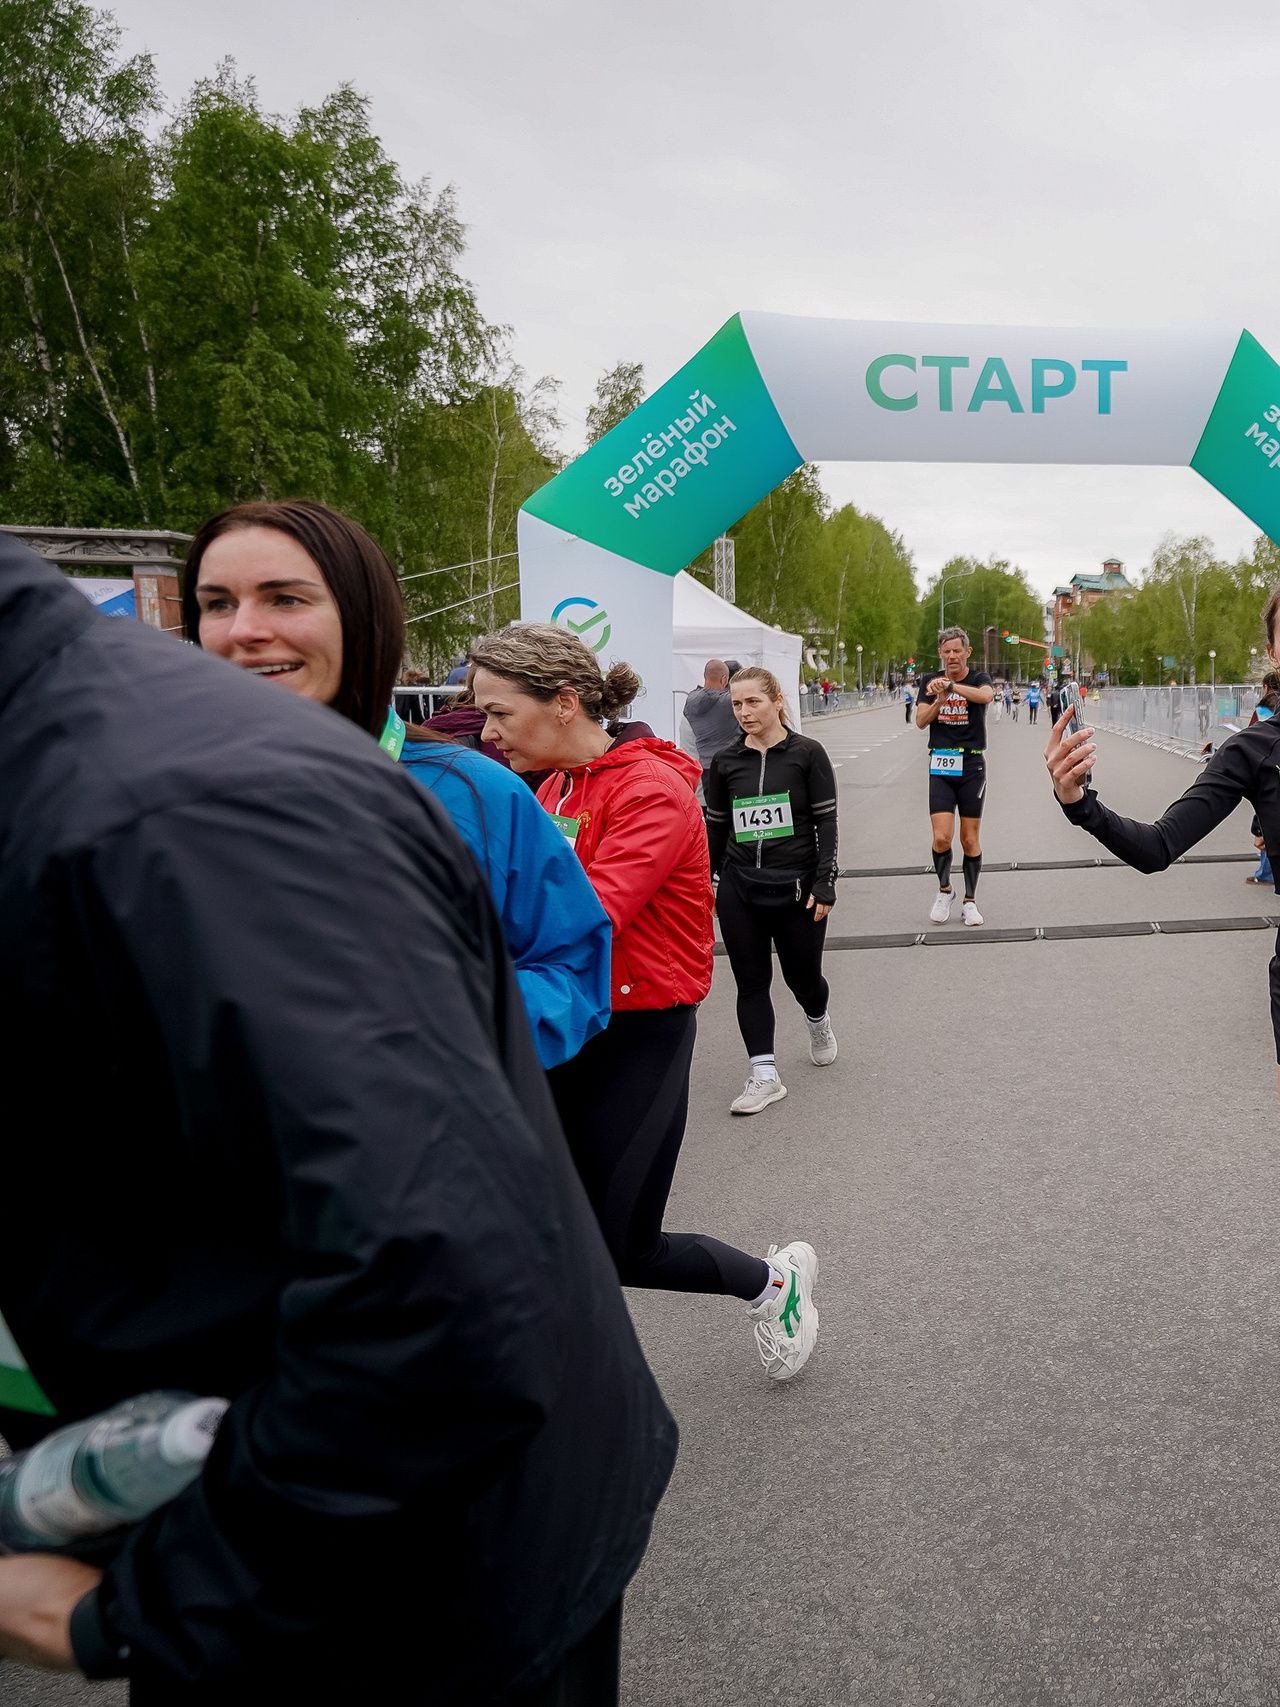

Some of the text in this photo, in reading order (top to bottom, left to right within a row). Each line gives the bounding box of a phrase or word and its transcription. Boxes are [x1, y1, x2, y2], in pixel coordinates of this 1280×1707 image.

[865, 353, 1128, 415] СТАРТ
[603, 389, 717, 498] зелёный
[622, 414, 738, 519] марафон
[936, 757, 956, 768] 789
[739, 806, 784, 828] 1431
